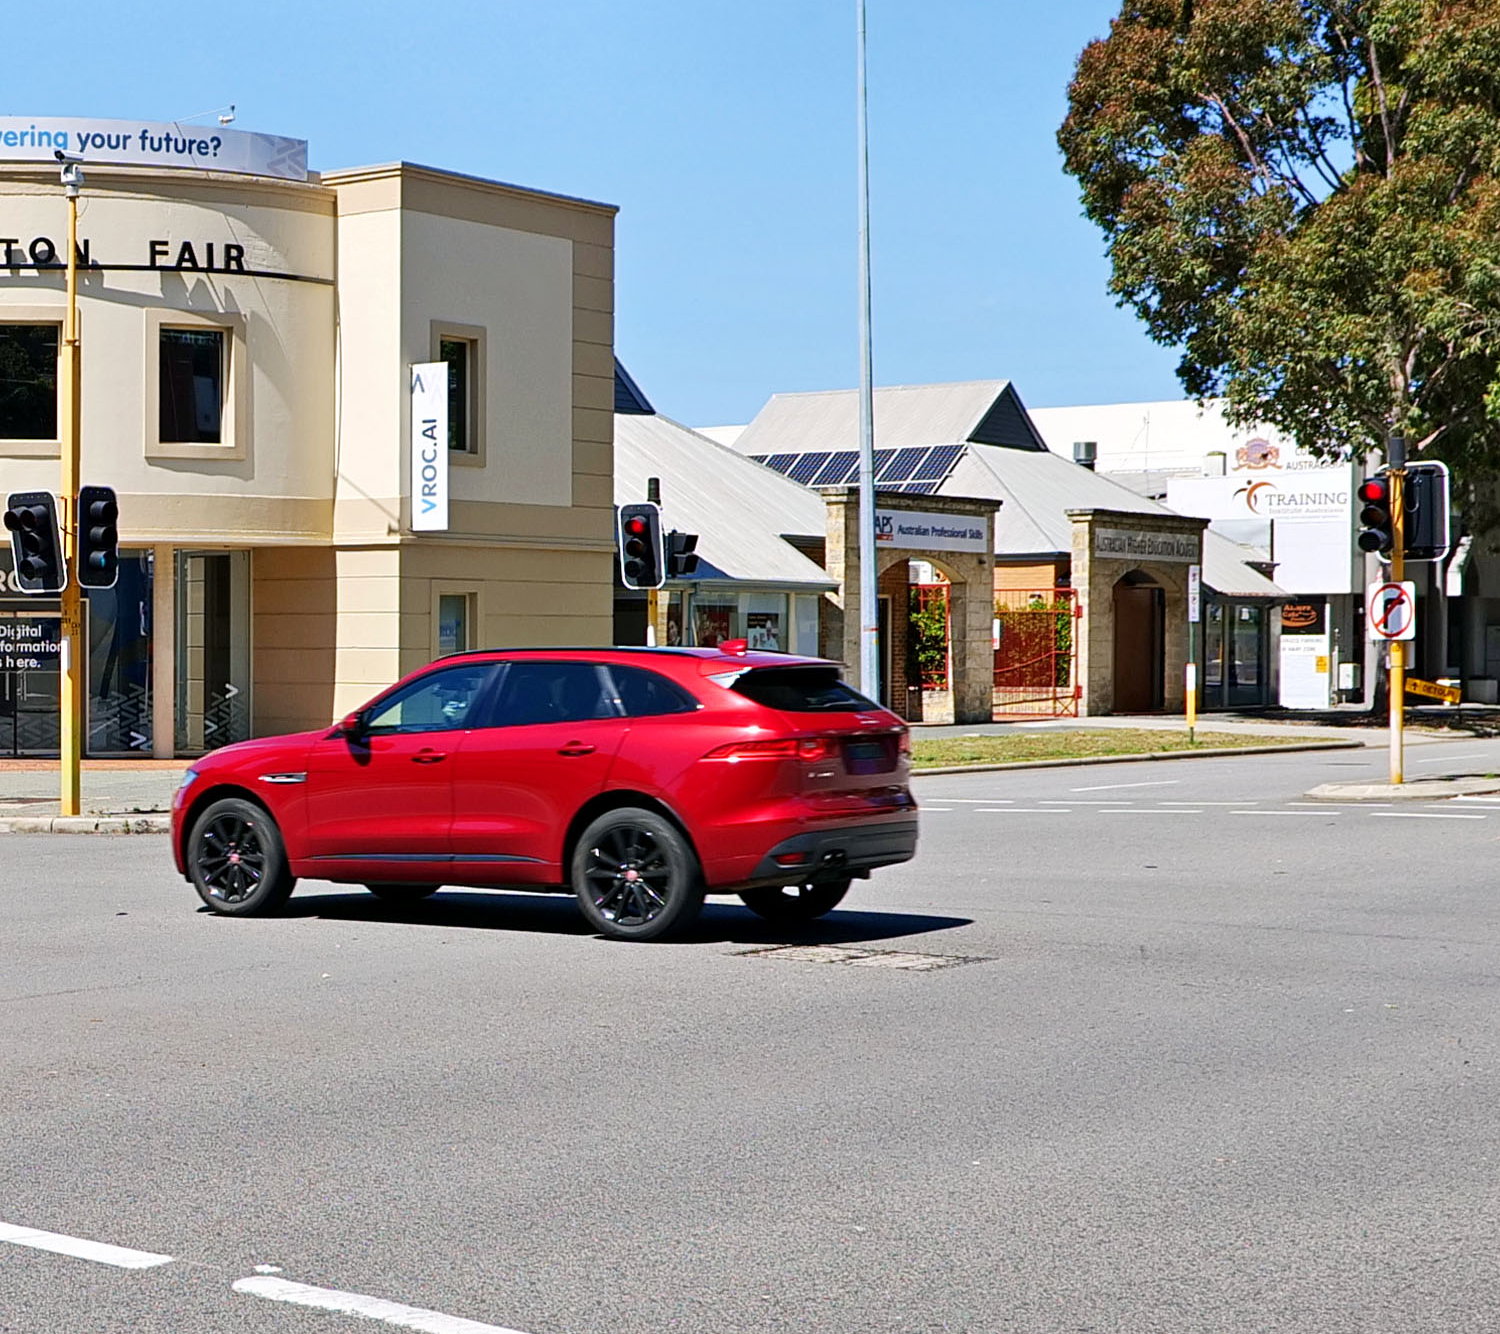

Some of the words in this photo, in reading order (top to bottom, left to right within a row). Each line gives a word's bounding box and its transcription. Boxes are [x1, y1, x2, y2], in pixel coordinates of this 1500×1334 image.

[77, 129, 133, 154] your
[139, 128, 223, 158] future?
[149, 240, 246, 270] FAIR
[421, 418, 438, 514] VROC.AI
[1265, 493, 1348, 506] TRAINING
[897, 524, 930, 536] Australian
[931, 526, 967, 539] Professional
[968, 529, 983, 540] Skills
[6, 655, 42, 668] here.
[1422, 683, 1456, 699] DETOUR
